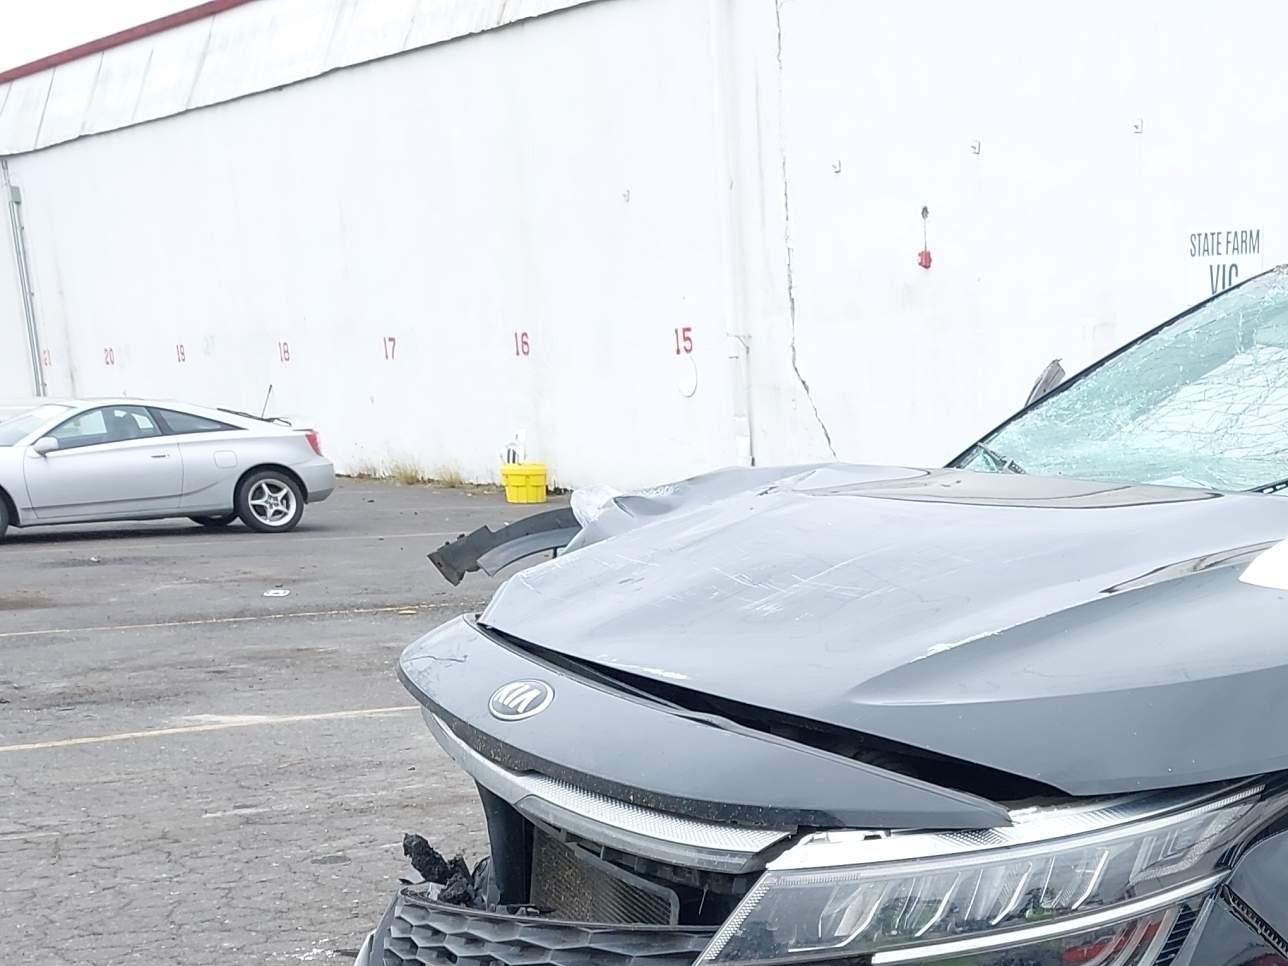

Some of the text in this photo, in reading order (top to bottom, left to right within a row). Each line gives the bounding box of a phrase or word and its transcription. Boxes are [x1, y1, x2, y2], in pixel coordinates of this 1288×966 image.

[1190, 229, 1260, 257] STATE FARM
[1209, 263, 1239, 295] VIC
[176, 344, 186, 362] 19
[278, 341, 290, 362] 18
[383, 336, 396, 360] 17
[515, 332, 530, 357] 16
[675, 327, 694, 354] 15
[104, 347, 115, 365] 20
[492, 682, 542, 714] KIA
